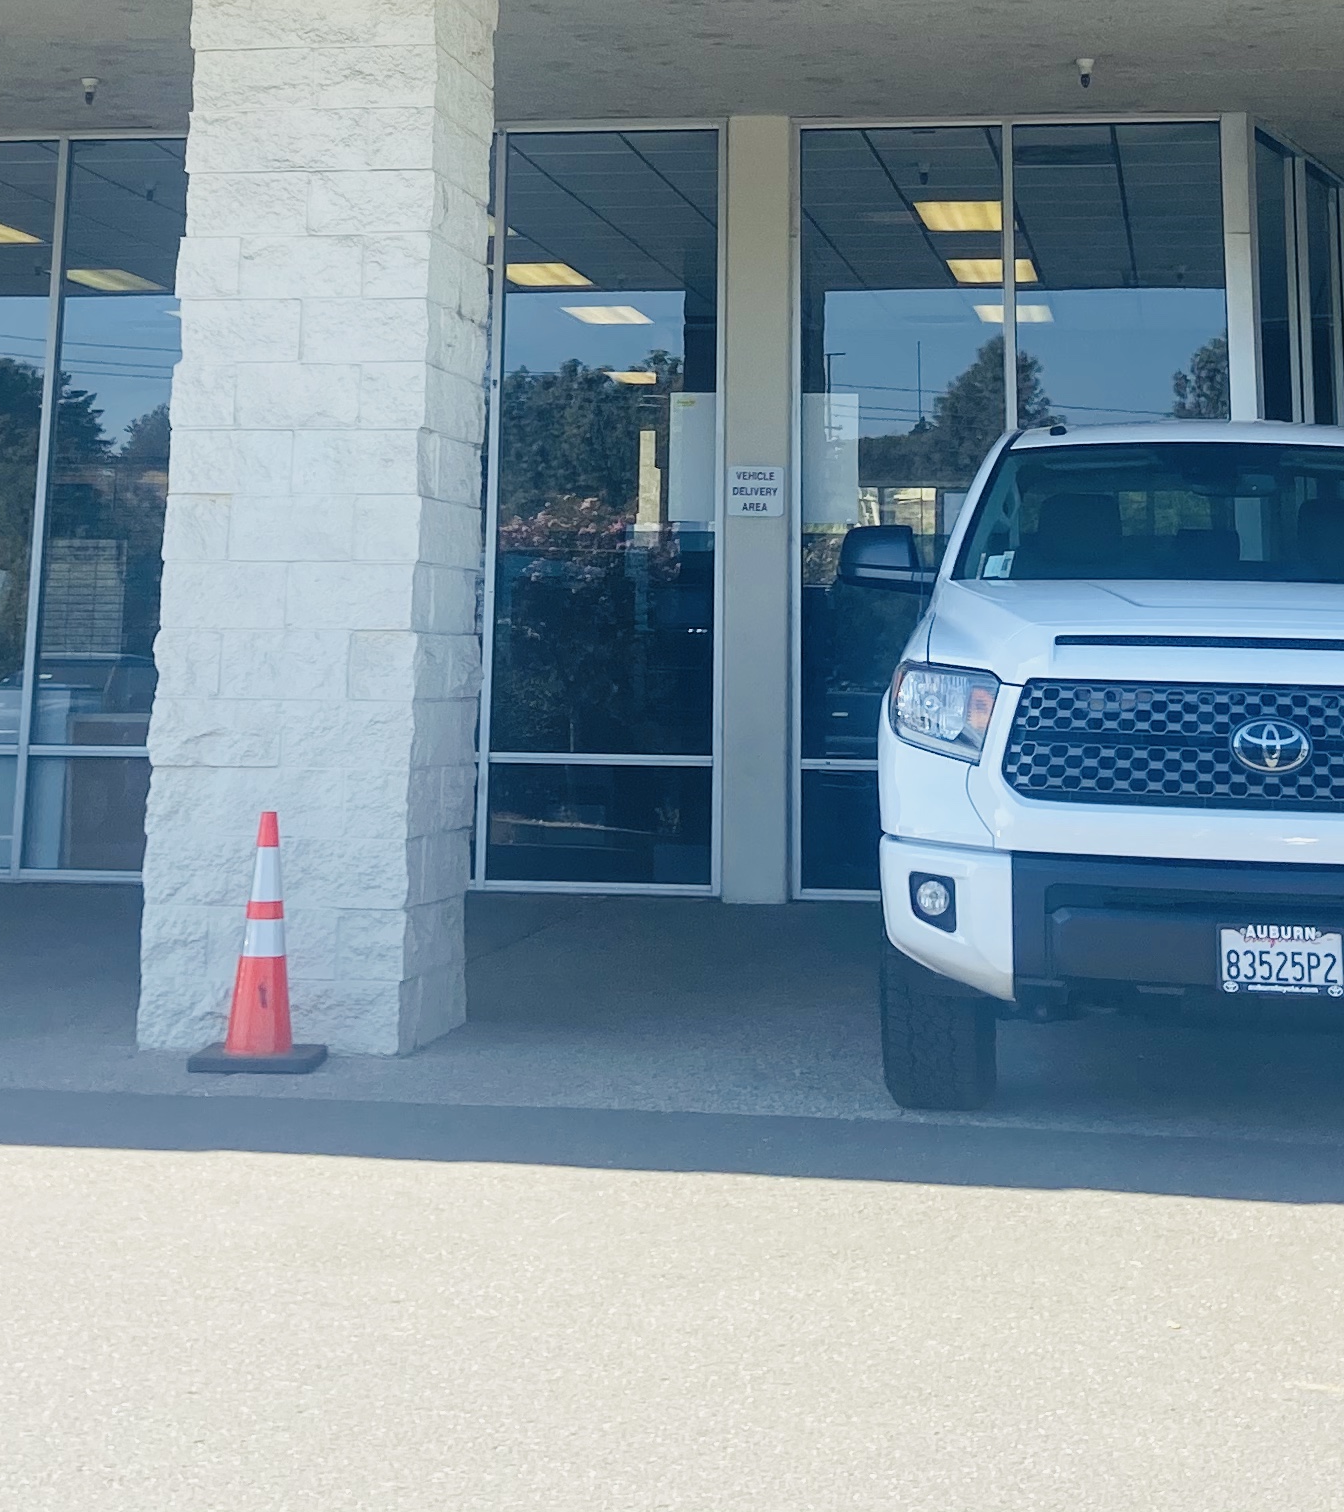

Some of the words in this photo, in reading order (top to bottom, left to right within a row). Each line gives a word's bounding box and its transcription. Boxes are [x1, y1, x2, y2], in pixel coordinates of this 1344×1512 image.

[736, 472, 775, 480] VEHICLE
[732, 487, 778, 496] DELIVERY
[742, 503, 768, 511] AREA
[1246, 925, 1316, 941] AUBURN
[1227, 949, 1338, 984] 83525P2
